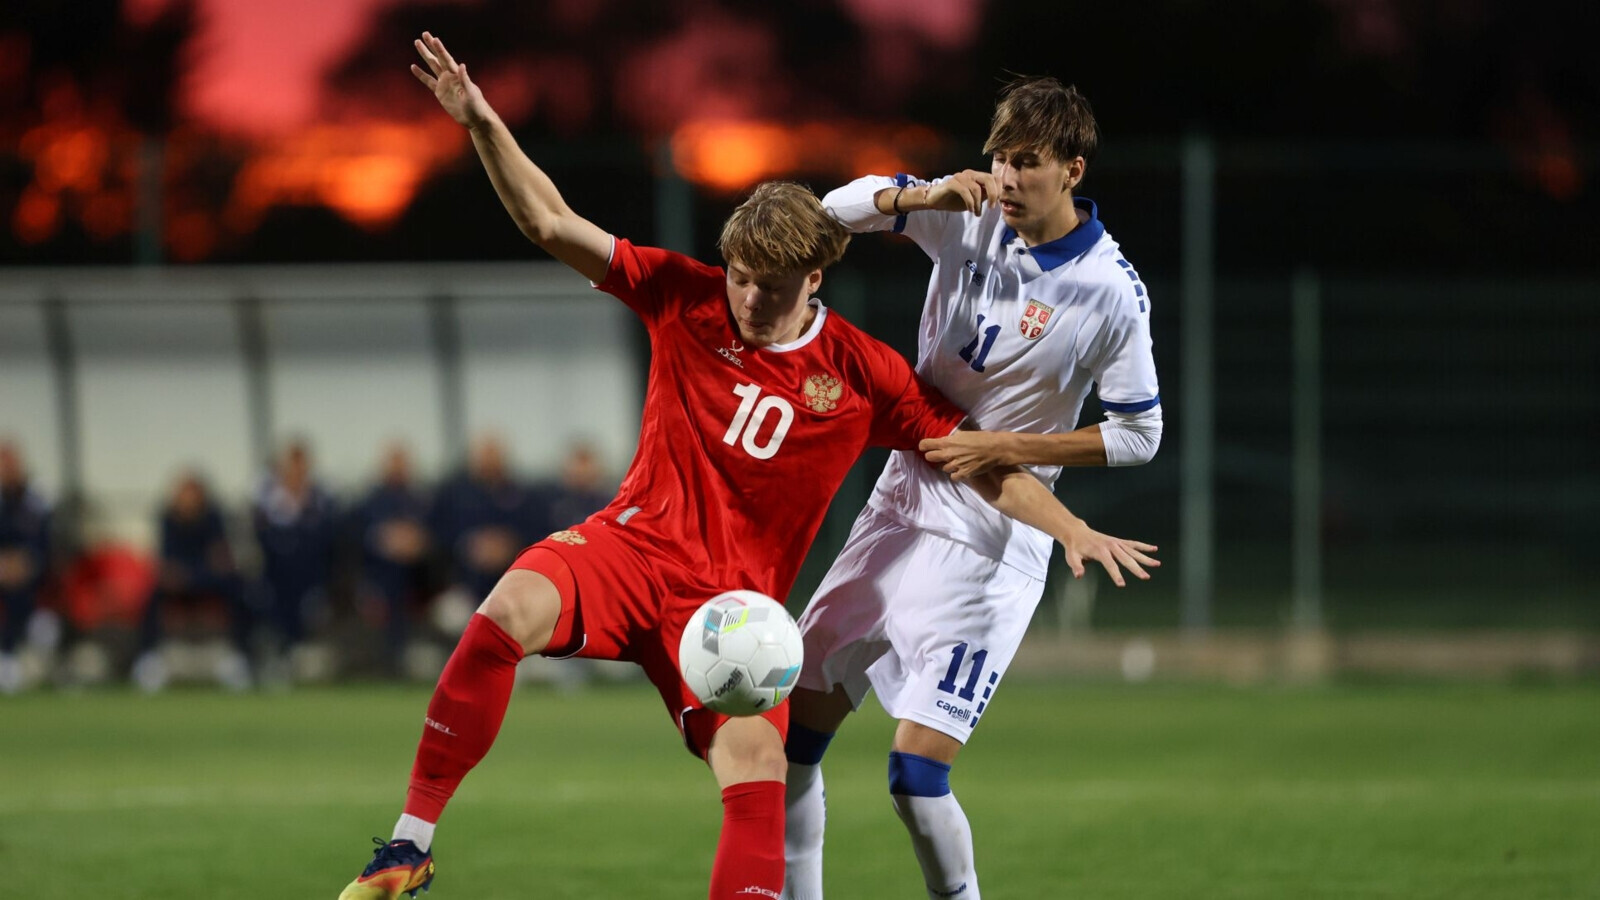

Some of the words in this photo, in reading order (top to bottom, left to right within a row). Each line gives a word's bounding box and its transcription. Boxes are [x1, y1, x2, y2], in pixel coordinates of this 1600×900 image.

[959, 314, 1001, 373] 11
[722, 382, 795, 460] 10
[715, 666, 743, 698] capelli
[937, 642, 988, 702] 11
[936, 699, 972, 721] capelli
